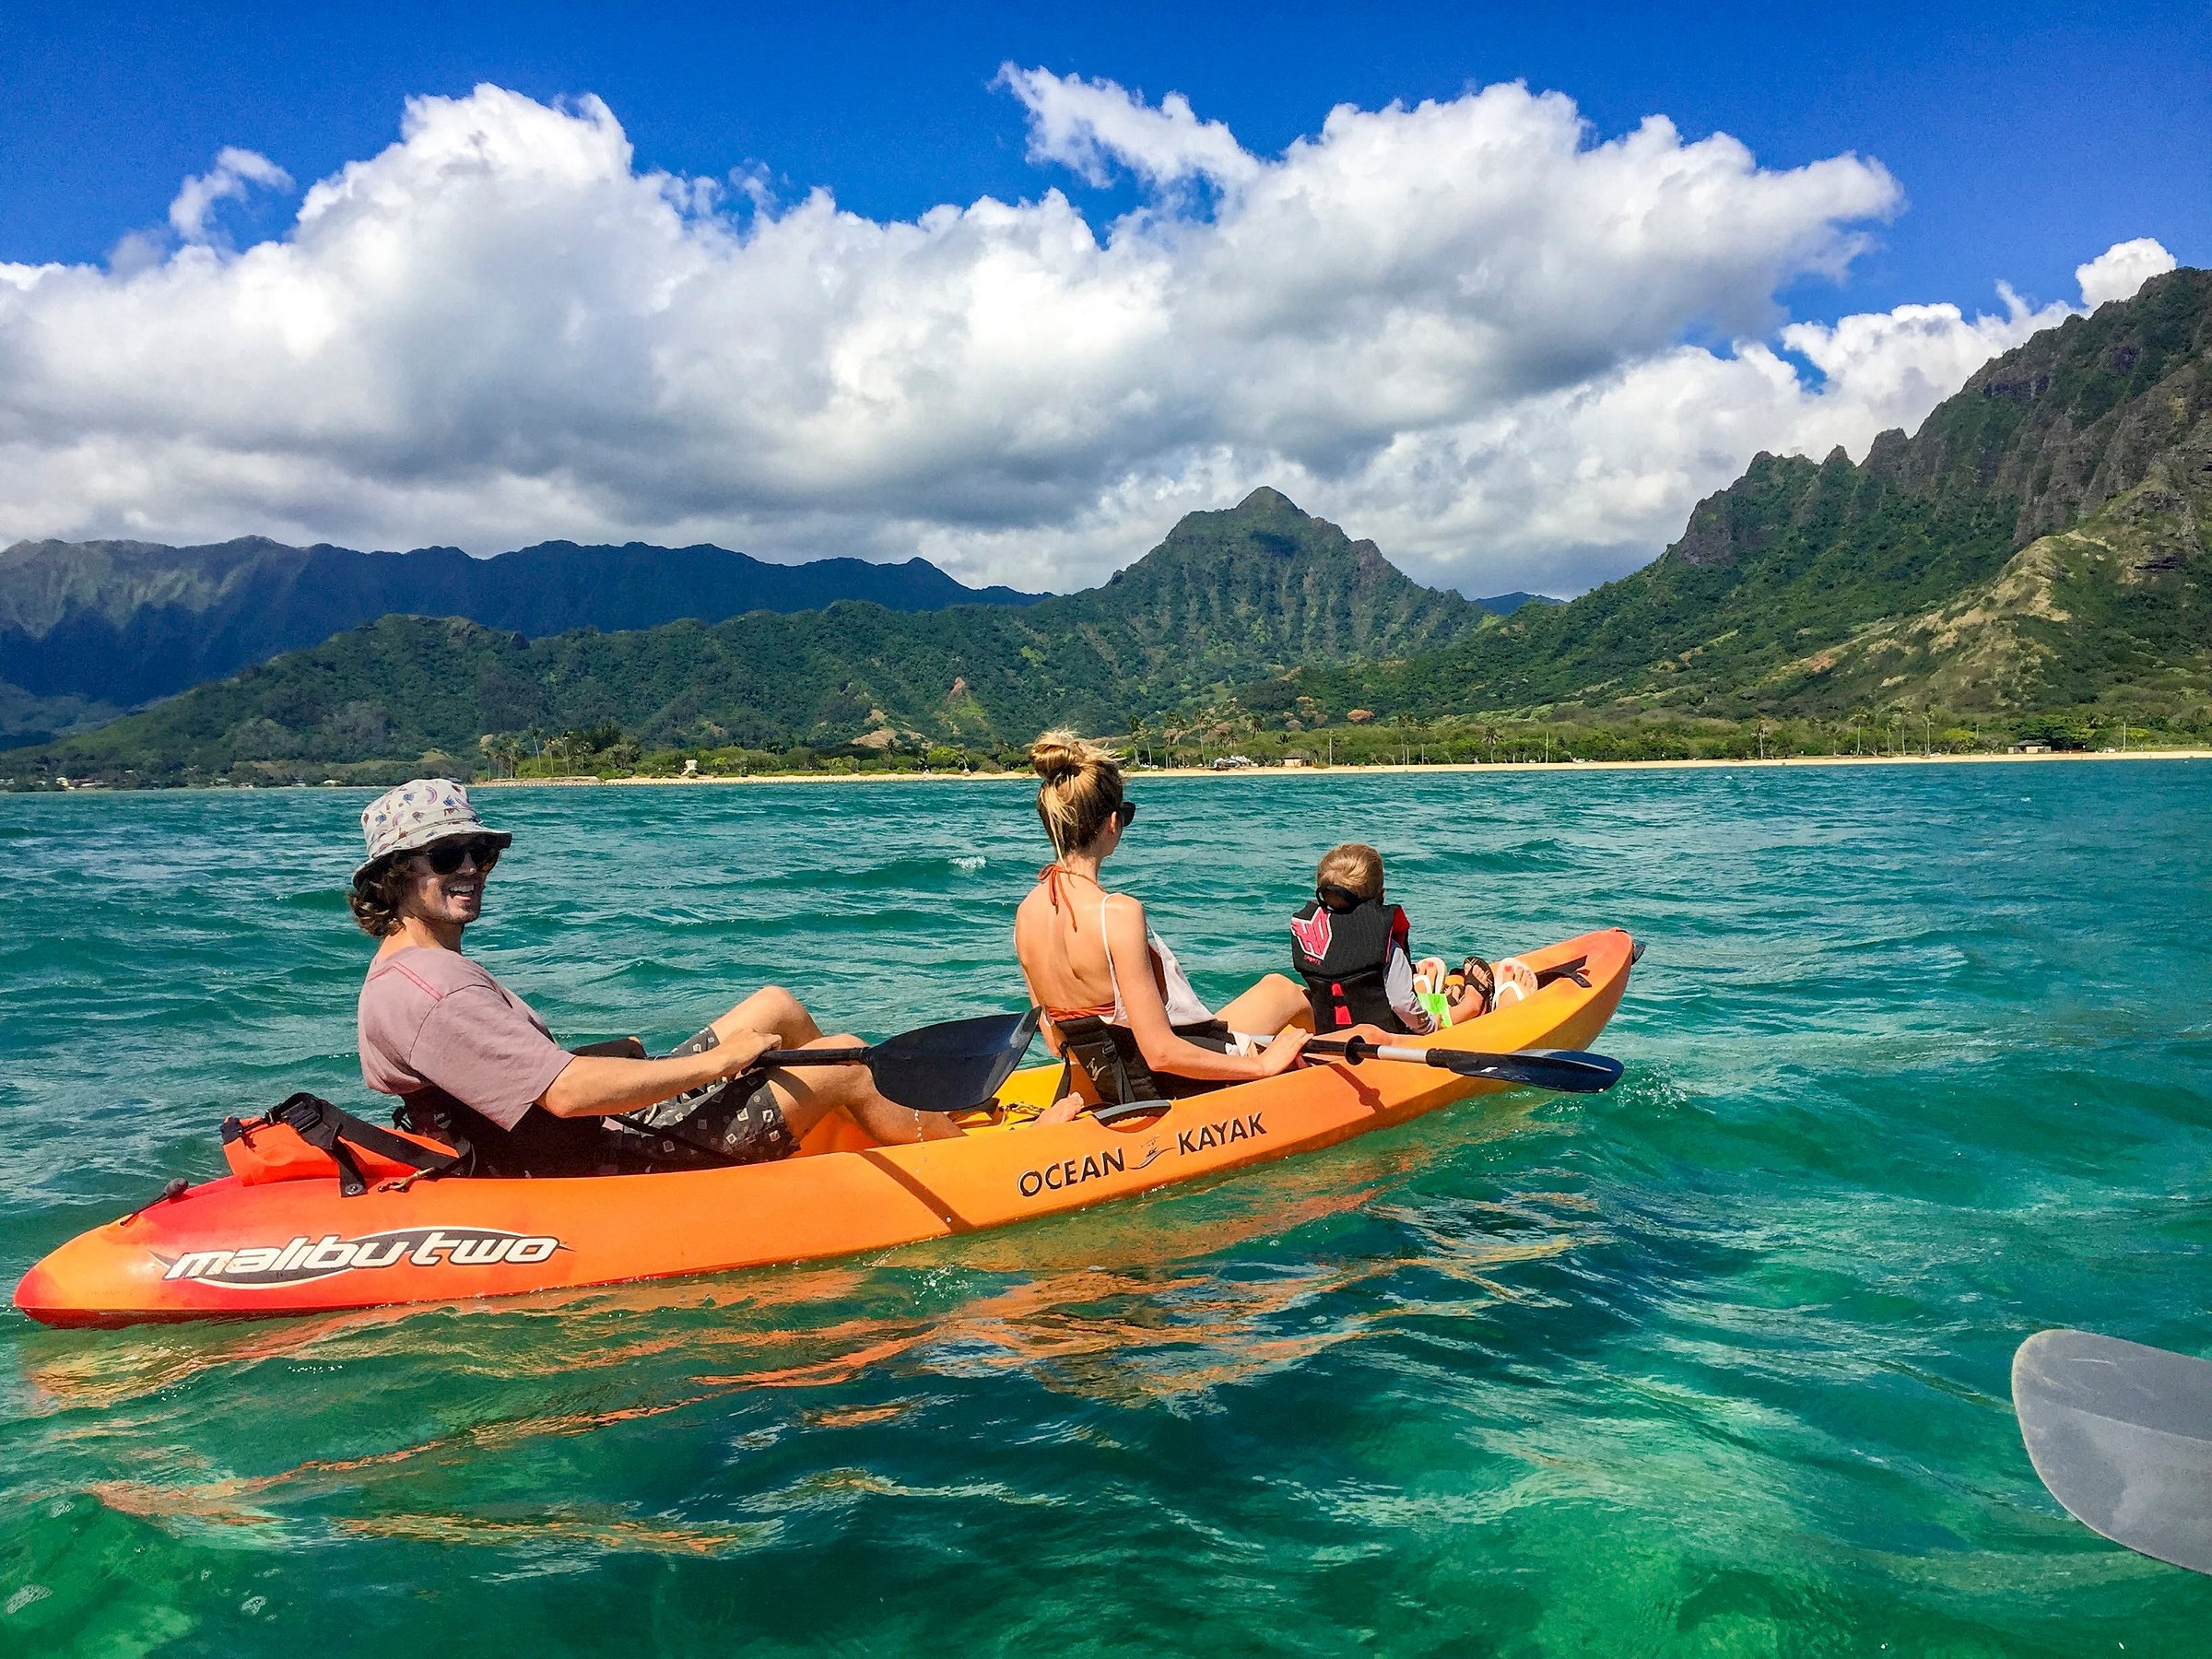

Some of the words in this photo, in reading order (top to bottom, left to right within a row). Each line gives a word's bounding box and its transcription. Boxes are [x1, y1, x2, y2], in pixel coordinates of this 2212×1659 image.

[1018, 1147, 1125, 1197] OCEAN
[1176, 1112, 1268, 1157] KAYAK
[163, 1235, 410, 1280] malibu
[410, 1231, 559, 1265] two
